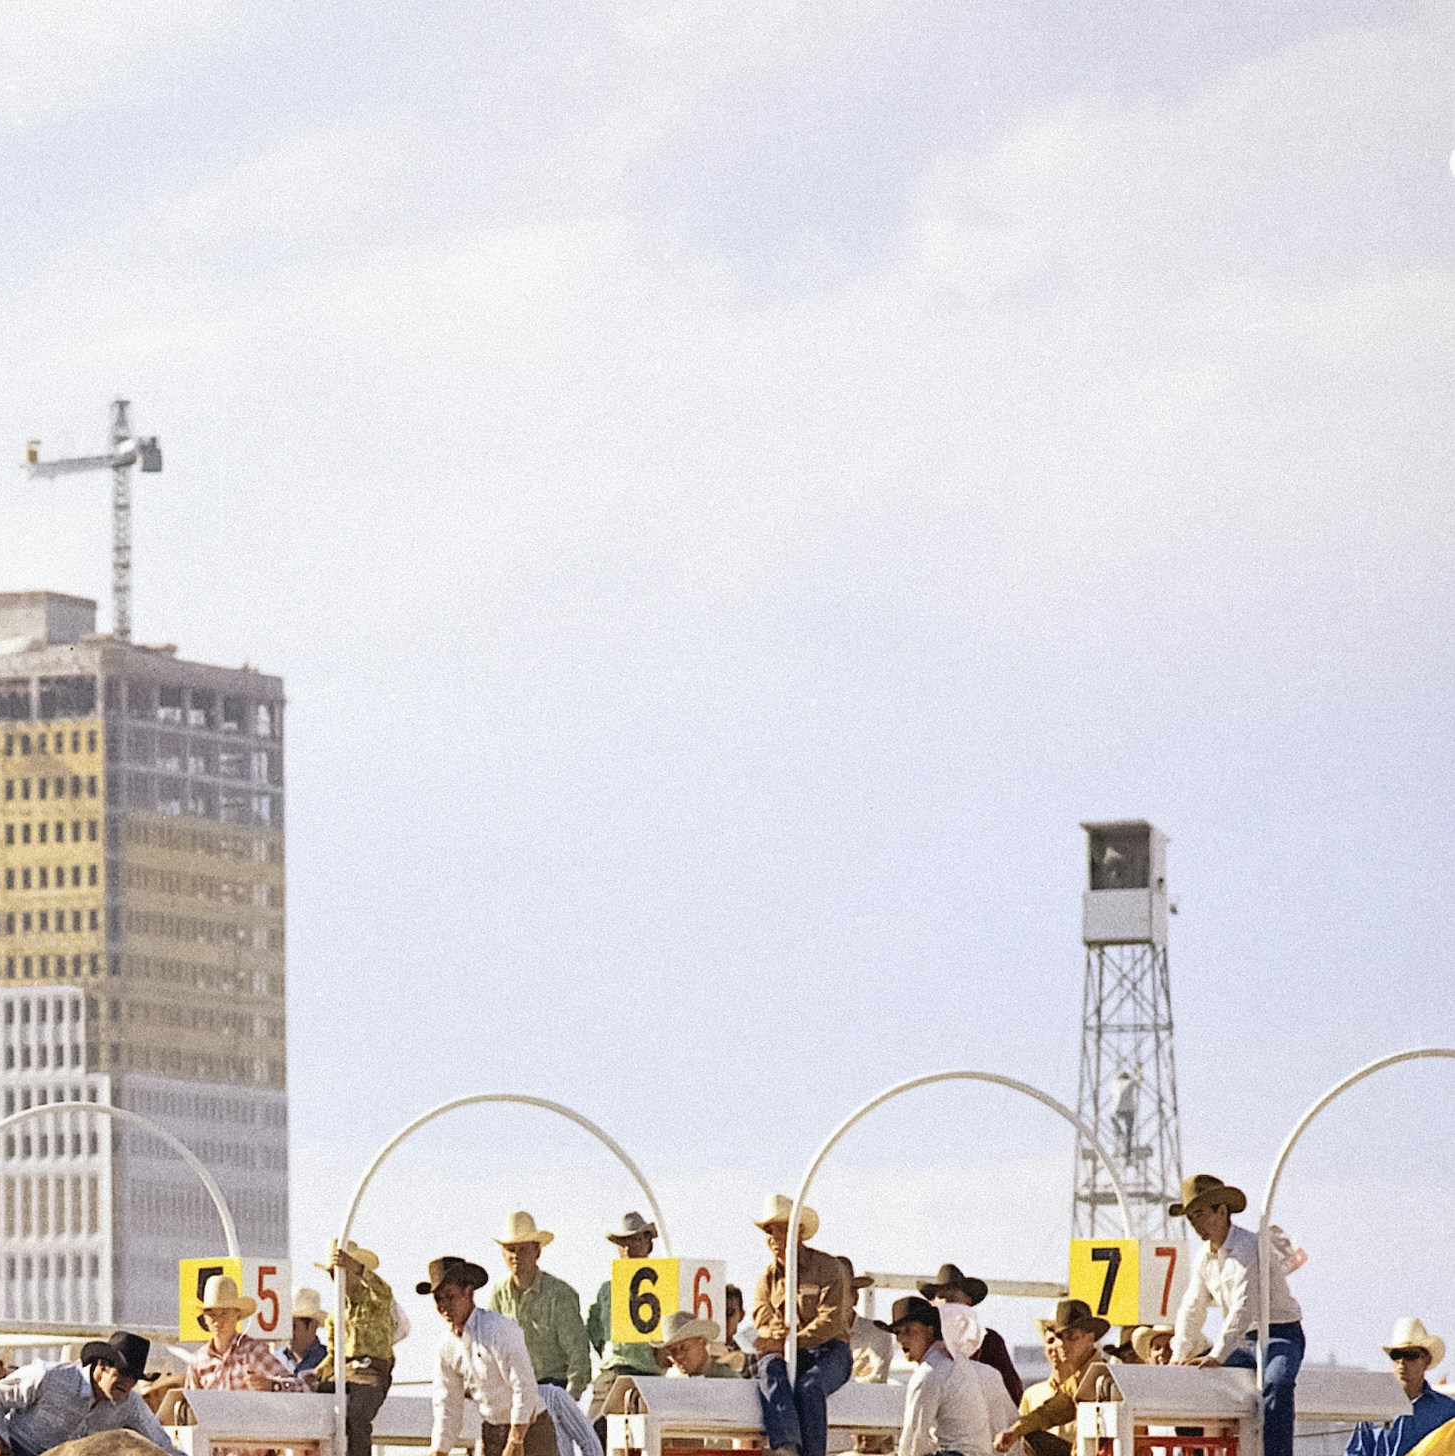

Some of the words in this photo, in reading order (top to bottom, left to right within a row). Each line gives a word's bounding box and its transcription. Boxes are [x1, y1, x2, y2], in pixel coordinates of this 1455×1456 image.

[257, 1265, 280, 1332] 5
[629, 1266, 661, 1334] 6
[1092, 1247, 1122, 1316] 7
[1154, 1246, 1177, 1317] 7
